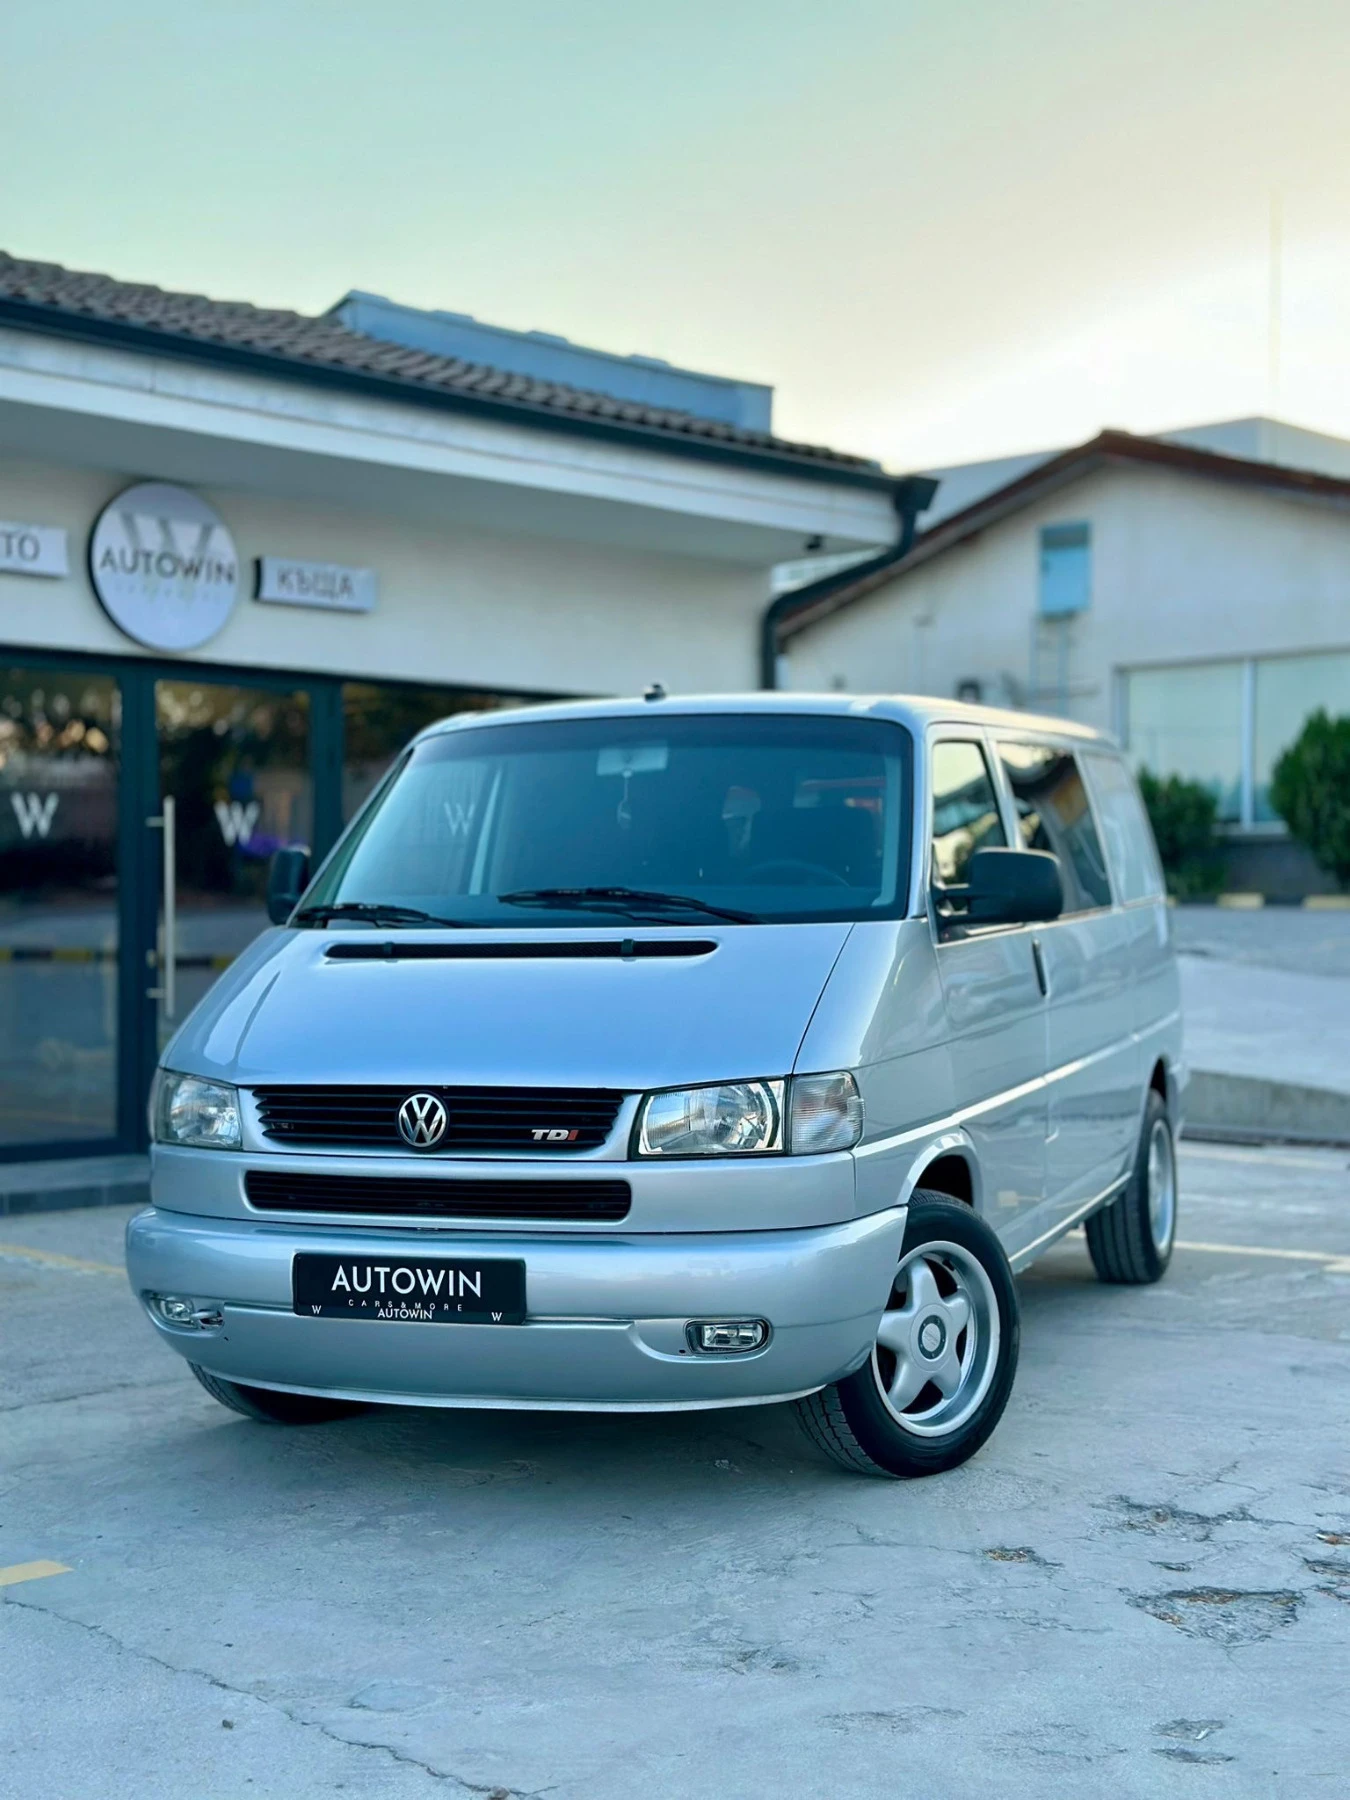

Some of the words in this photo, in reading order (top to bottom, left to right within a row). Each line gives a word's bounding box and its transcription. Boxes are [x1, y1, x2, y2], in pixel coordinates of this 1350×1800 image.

[100, 547, 235, 585] AUTOWIN
[277, 567, 356, 601] КЪЩА
[10, 792, 59, 839] W
[214, 801, 260, 847] W
[443, 801, 475, 836] W
[531, 1129, 579, 1141] TDI
[331, 1264, 482, 1298] AUTOWIN
[311, 1304, 322, 1315] W
[377, 1308, 433, 1320] AUTOWIN
[491, 1311, 503, 1322] W
